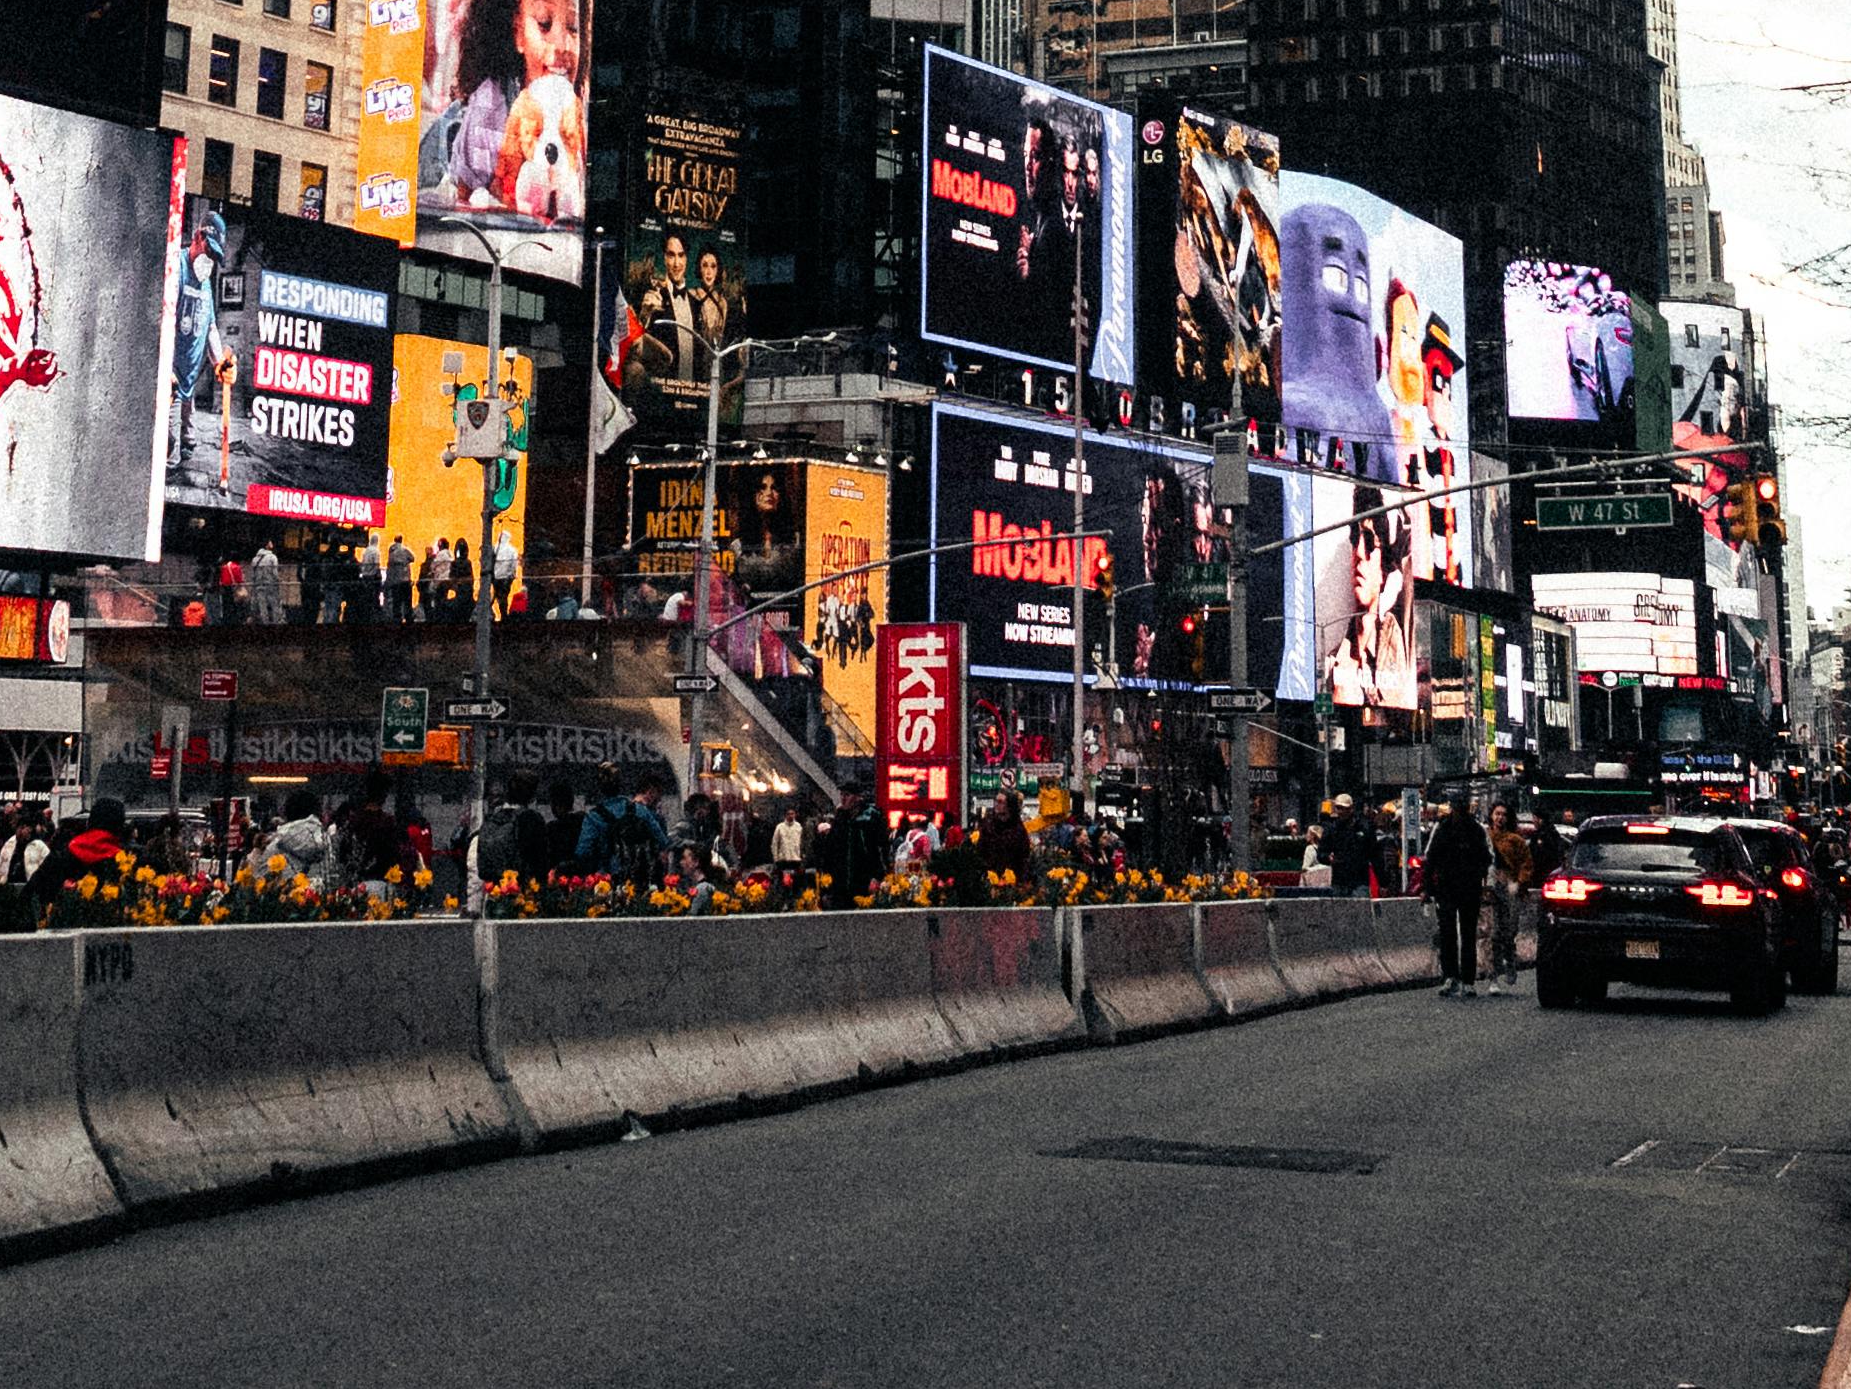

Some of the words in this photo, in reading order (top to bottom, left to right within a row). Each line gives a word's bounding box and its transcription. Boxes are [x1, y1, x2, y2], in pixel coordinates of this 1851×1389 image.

[366, 84, 414, 116] Live
[698, 123, 741, 139] BROADWAY
[1143, 149, 1164, 164] LG
[361, 177, 409, 210] Live
[655, 185, 728, 221] GATSBY
[262, 273, 386, 322] RESPONDING
[258, 311, 323, 352] WHEN
[256, 350, 370, 401] DISASTER
[1022, 369, 1133, 427] 150
[251, 395, 355, 447] STRIKES
[268, 489, 373, 522] IRUSA.ORG/USA
[1569, 504, 1585, 521] W
[1594, 502, 1614, 520] 47
[1622, 501, 1640, 520] St
[1017, 602, 1039, 622] NEW
[1040, 604, 1071, 623] SERIES
[1569, 606, 1611, 622] ANATOMY
[1005, 622, 1028, 643] NOW
[1029, 624, 1076, 646] STREAMIN
[897, 631, 948, 754] tkts
[1216, 696, 1237, 707] ONE
[1243, 696, 1265, 708] WAY
[387, 716, 423, 727] South
[453, 704, 473, 715] ONE
[481, 704, 501, 715] WAY
[4, 790, 37, 801] GRETEST
